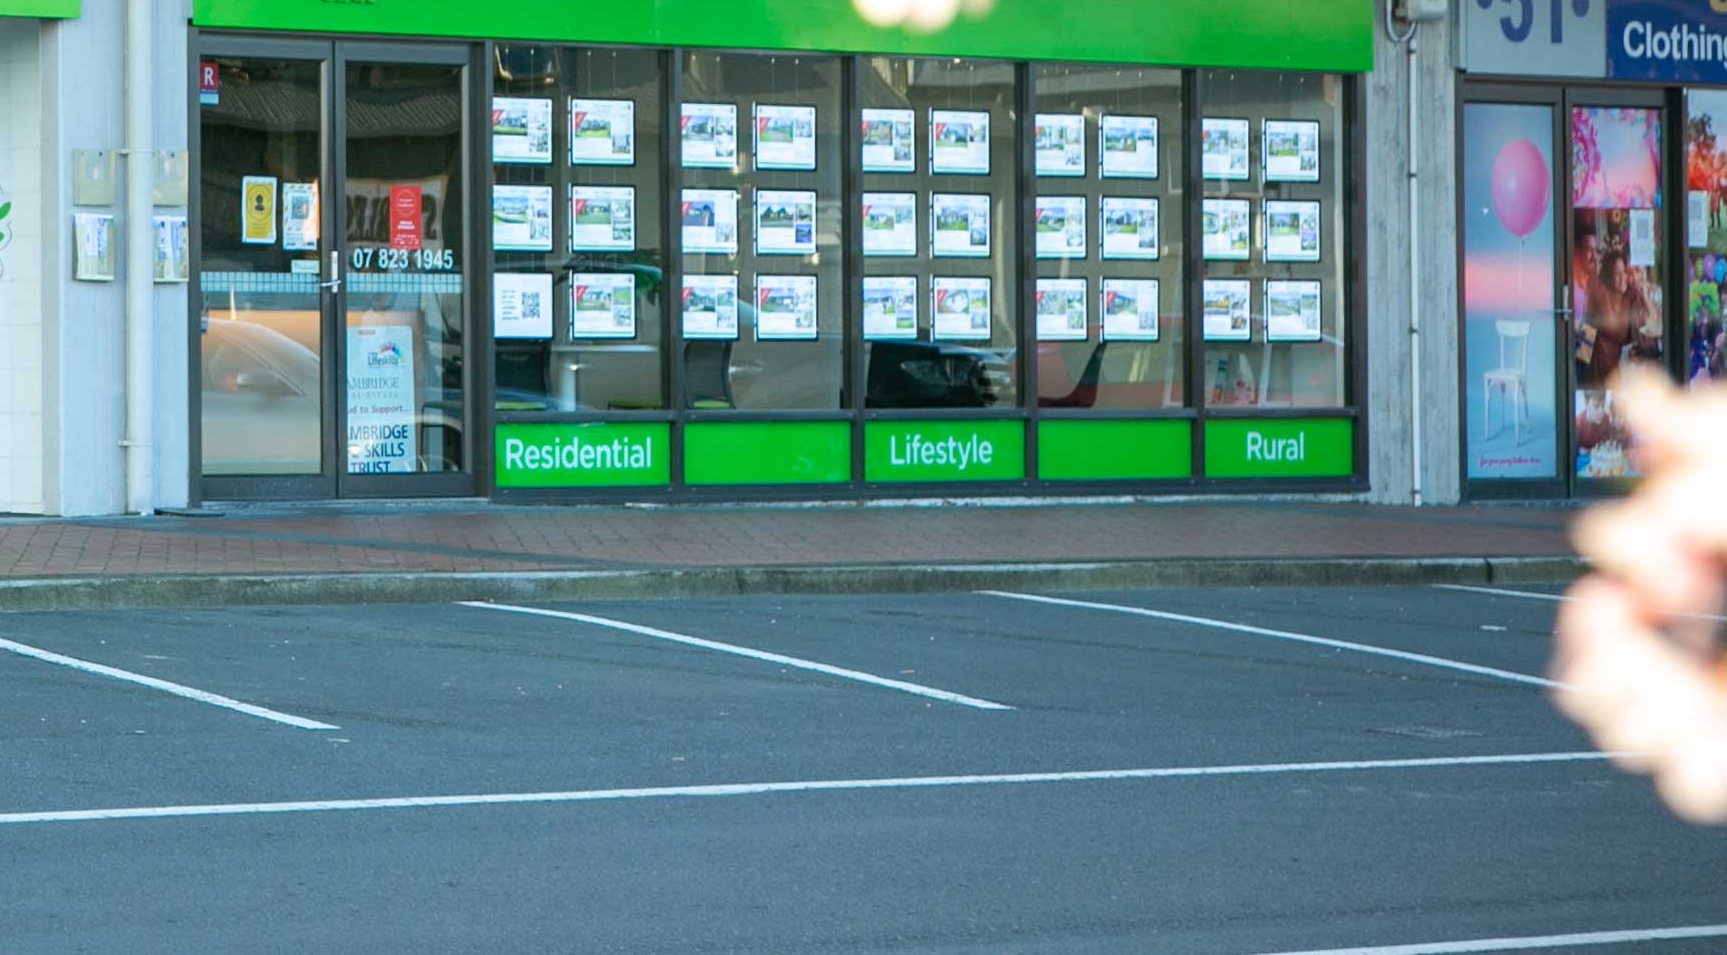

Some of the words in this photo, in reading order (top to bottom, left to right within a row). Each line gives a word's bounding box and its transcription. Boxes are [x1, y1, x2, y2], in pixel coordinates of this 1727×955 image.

[204, 66, 215, 86] R
[353, 247, 374, 269] 07
[378, 247, 410, 270] 823
[413, 248, 454, 270] 1945
[364, 442, 406, 458] SKILLS
[505, 436, 652, 470] Residential
[890, 432, 993, 470] Lifestyle
[1246, 431, 1305, 461] Rural
